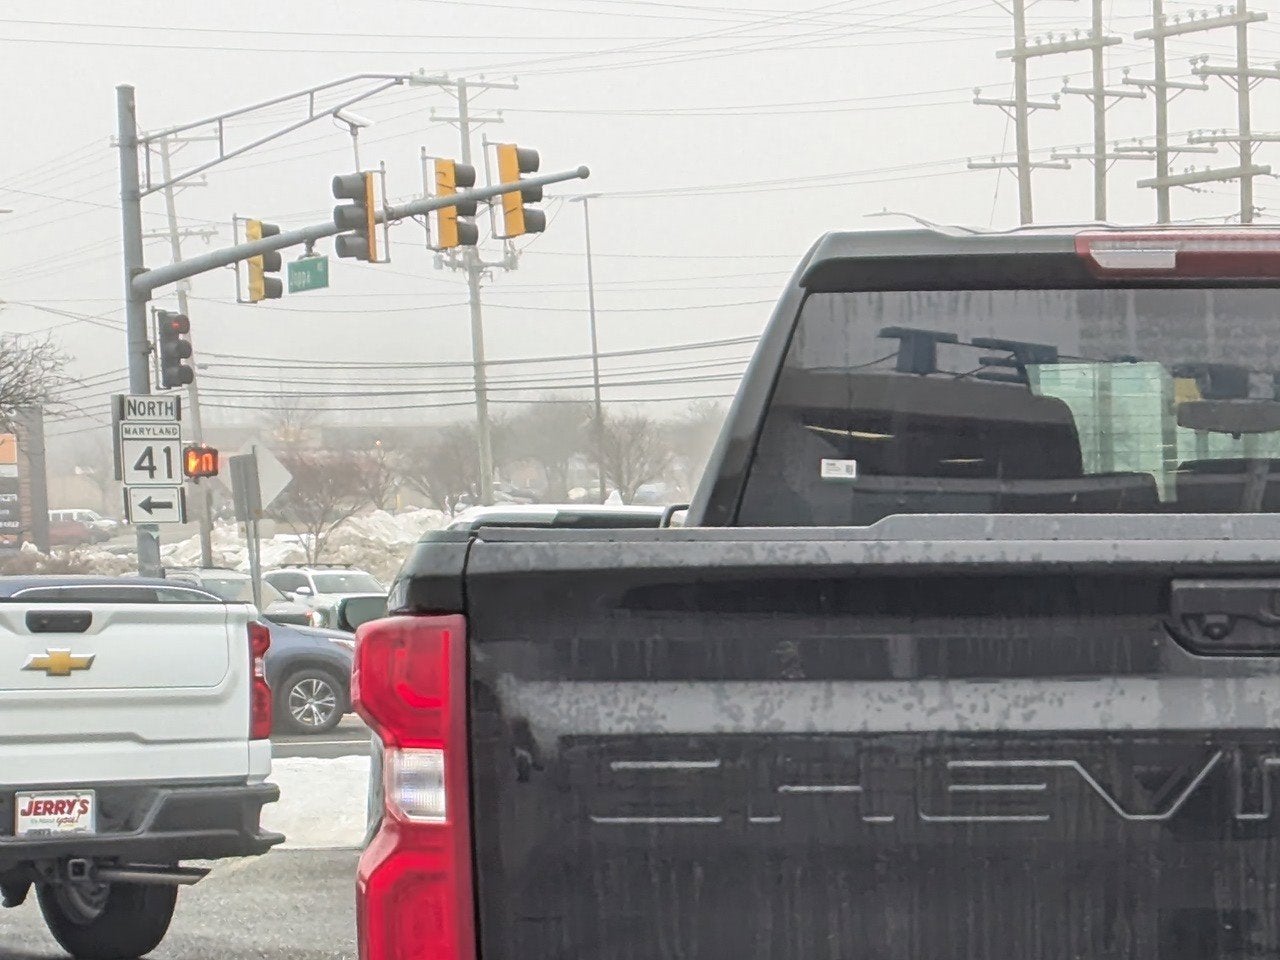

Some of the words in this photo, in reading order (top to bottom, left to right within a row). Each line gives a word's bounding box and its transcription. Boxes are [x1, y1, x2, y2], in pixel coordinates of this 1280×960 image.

[127, 399, 174, 416] NORTH
[124, 426, 178, 436] MARYLAND
[133, 445, 174, 479] 41
[20, 799, 90, 816] JERRY'S
